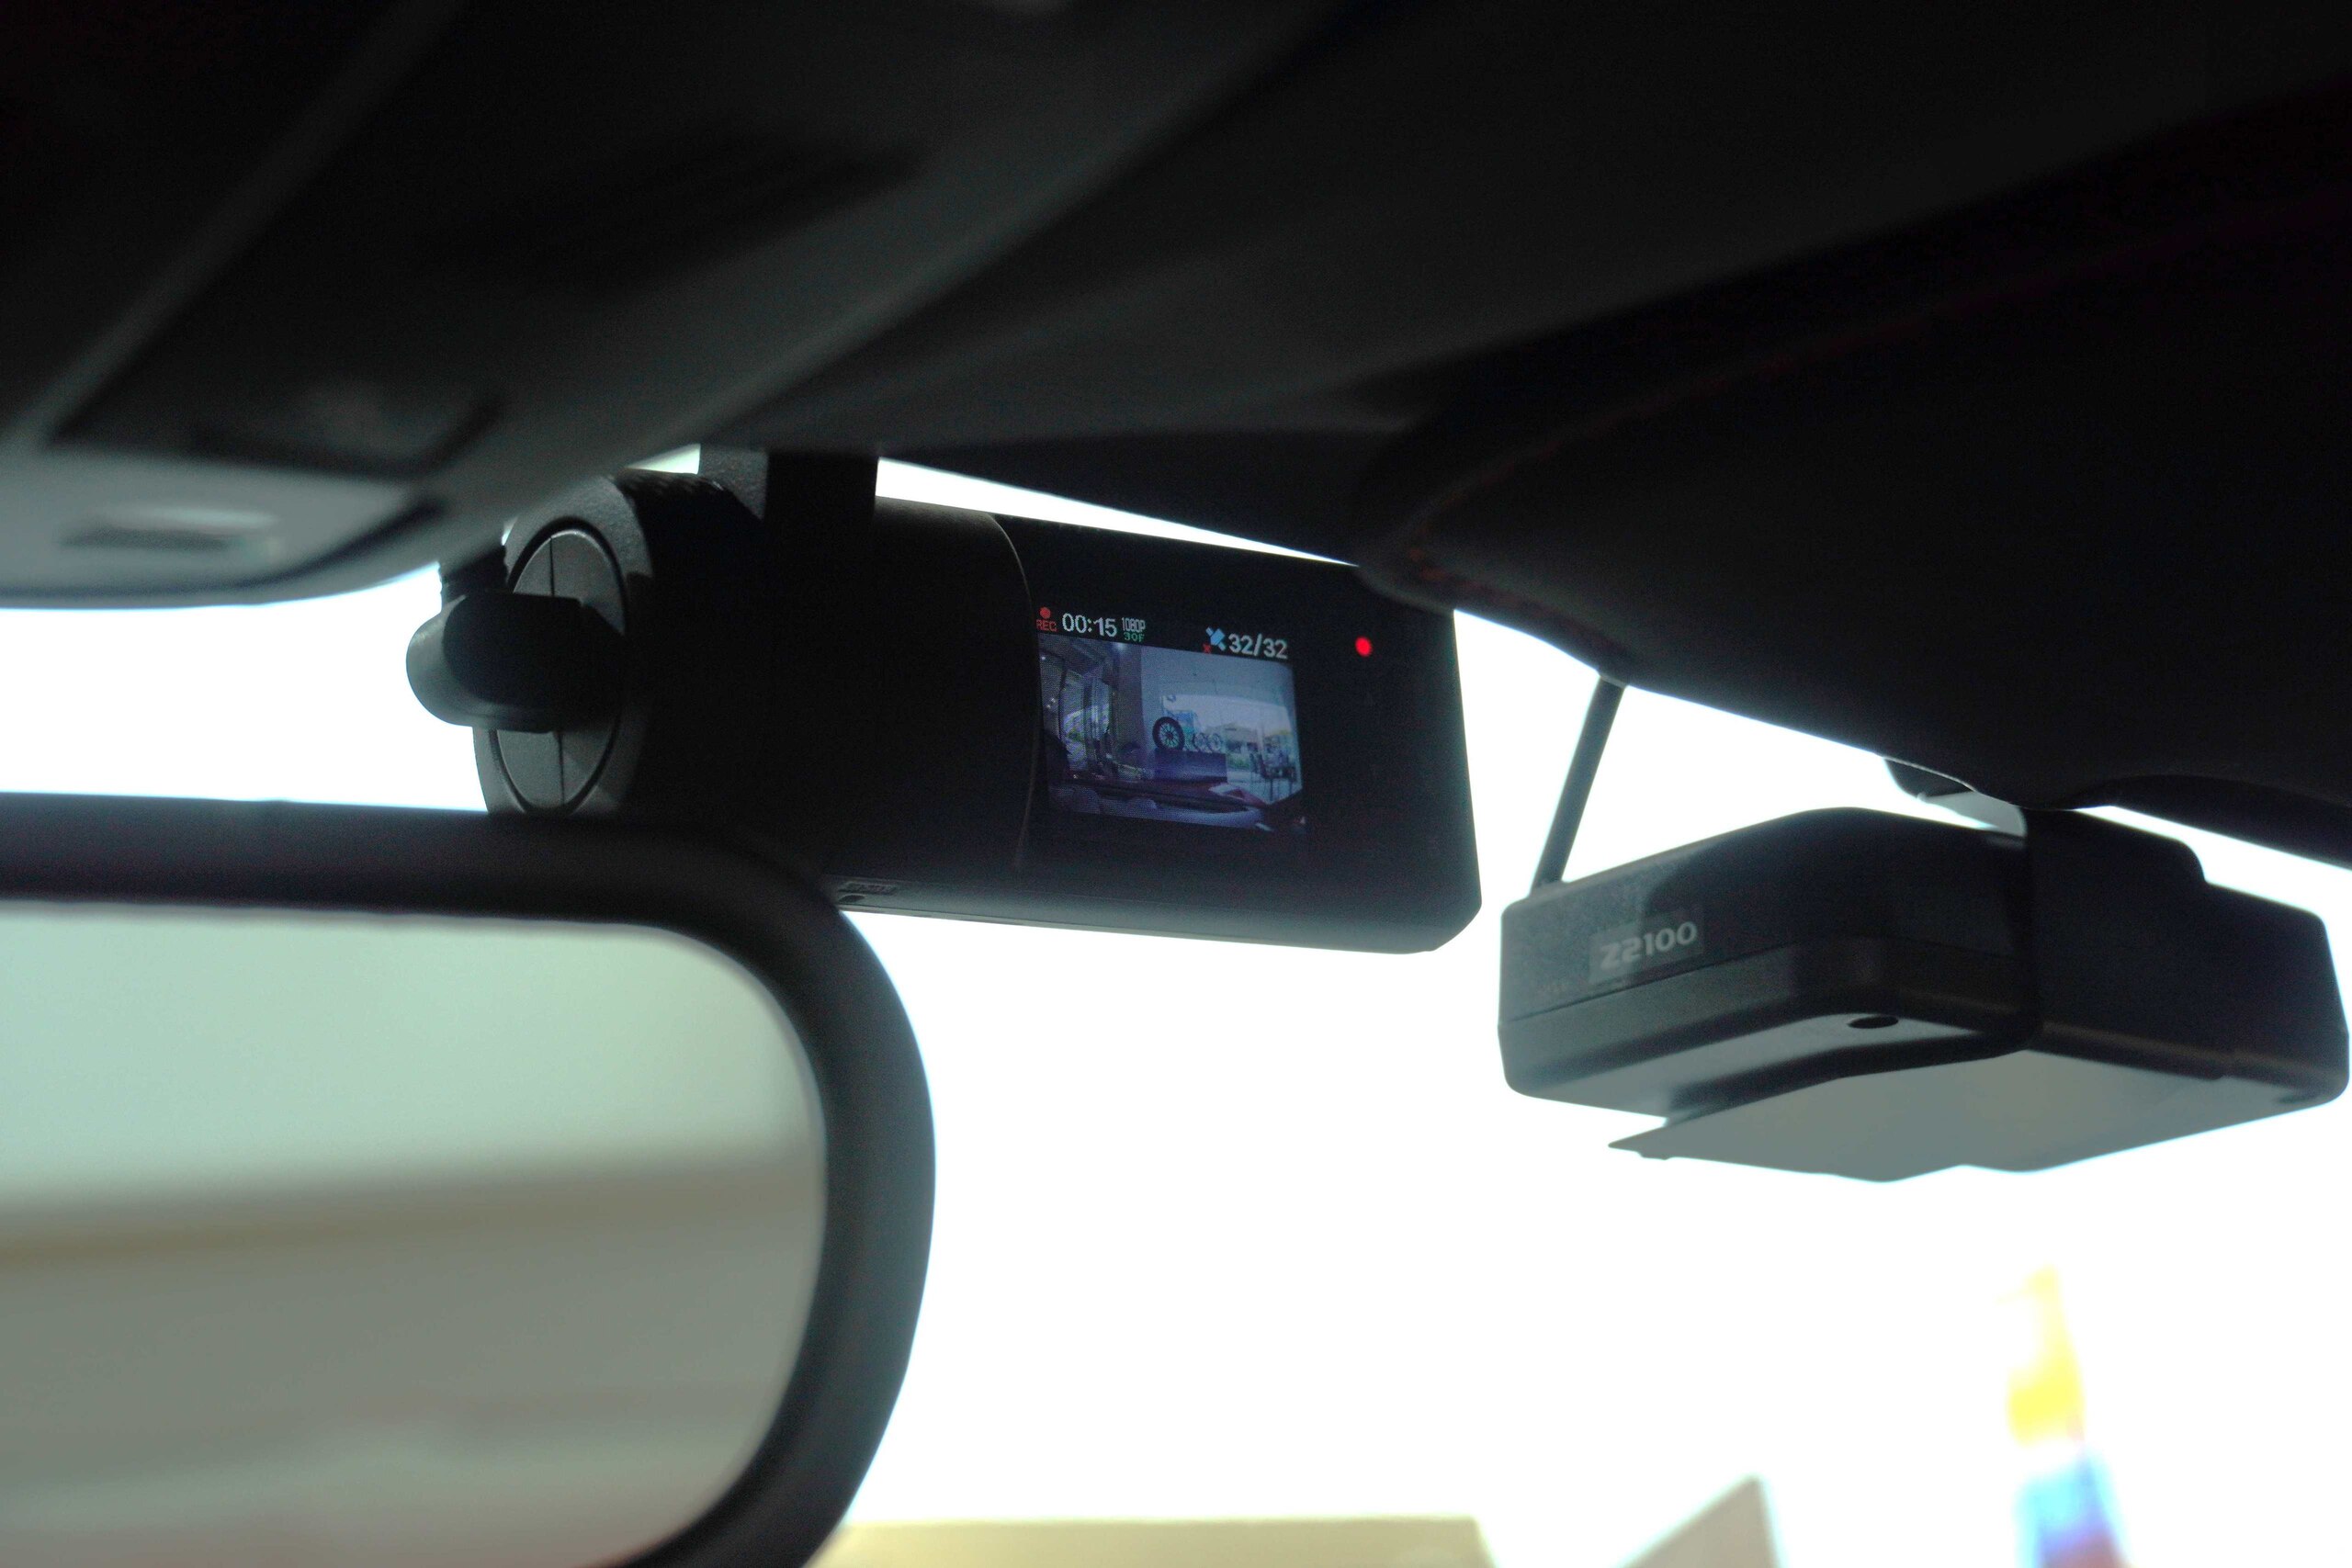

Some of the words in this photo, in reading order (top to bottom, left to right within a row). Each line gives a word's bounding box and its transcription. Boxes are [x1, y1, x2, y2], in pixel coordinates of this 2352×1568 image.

[1035, 619, 1057, 632] REC
[1062, 613, 1117, 637] 00:15
[1121, 617, 1147, 633] 1080P
[1228, 633, 1288, 660] 32/32
[1600, 922, 1697, 969] Z2100
